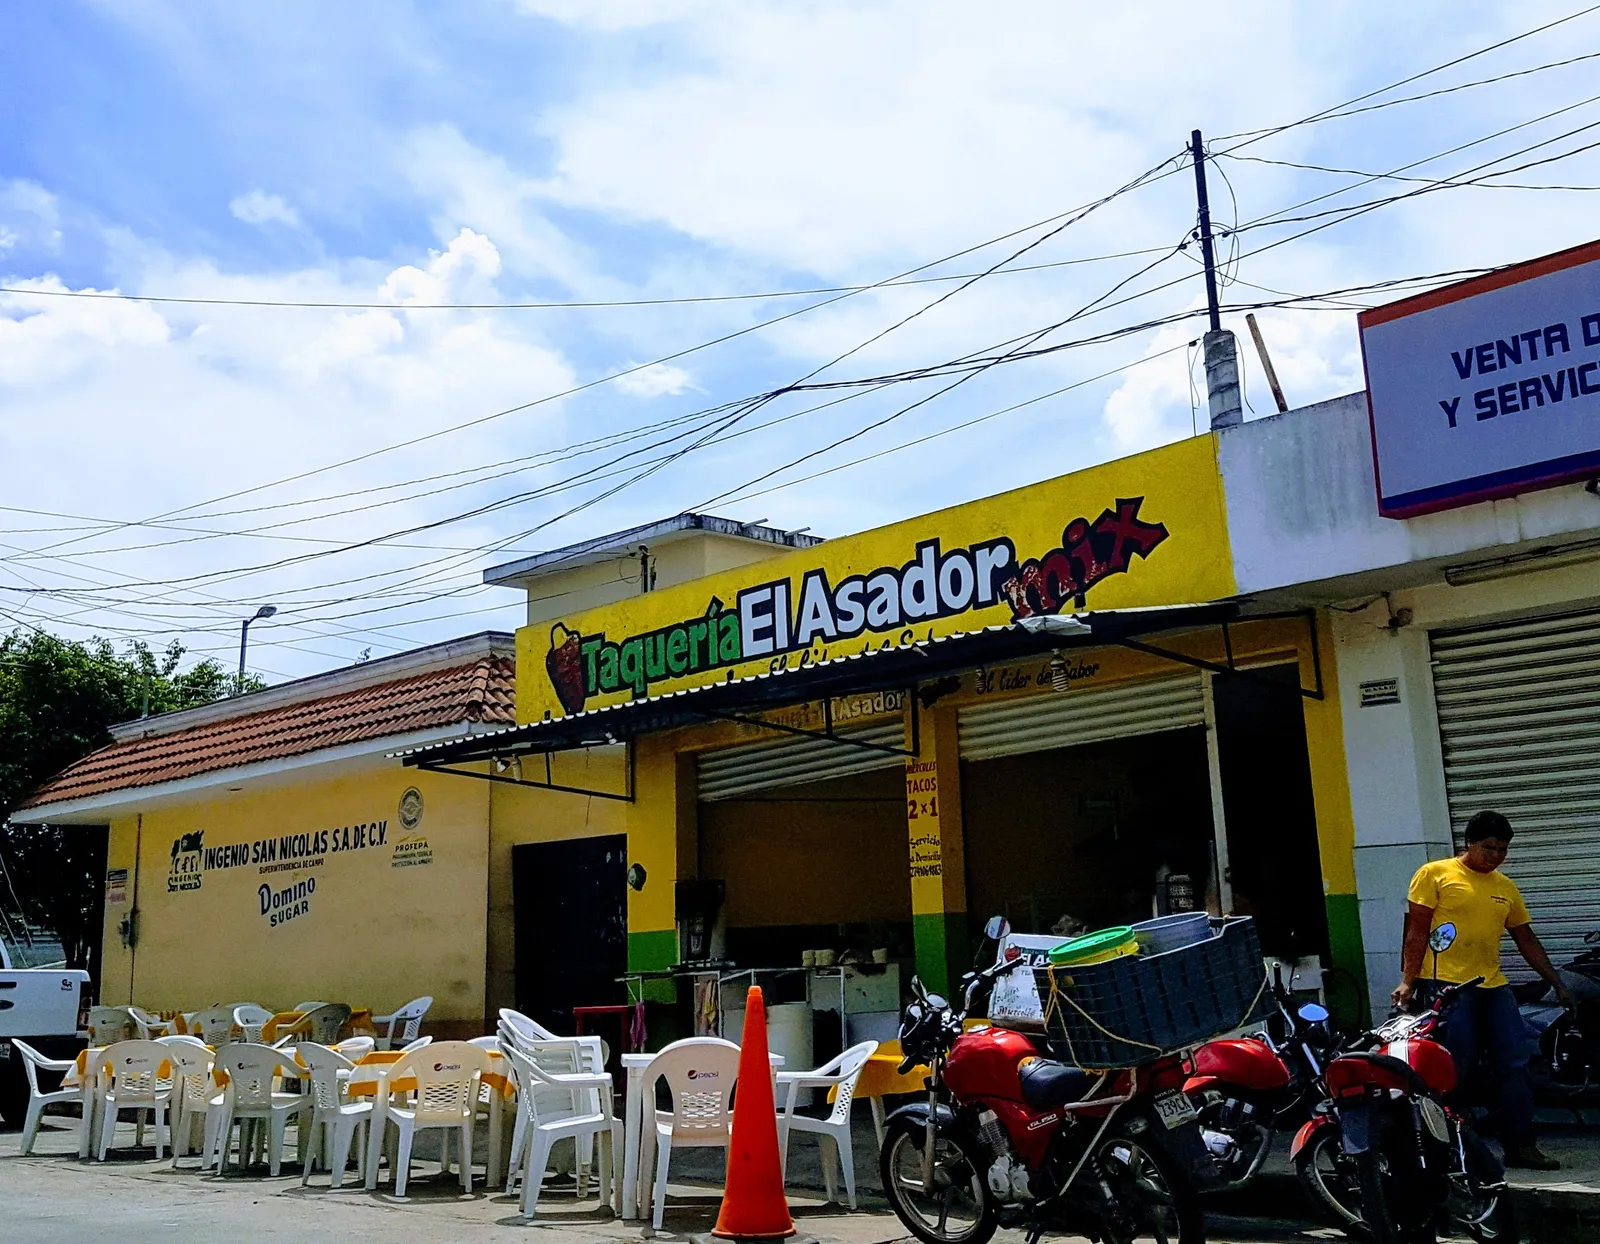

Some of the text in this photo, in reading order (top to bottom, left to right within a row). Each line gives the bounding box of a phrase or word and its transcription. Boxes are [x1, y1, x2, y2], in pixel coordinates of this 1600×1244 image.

[1451, 322, 1571, 380] VENTA
[1439, 361, 1600, 428] Y SERVIC
[580, 498, 1168, 694] Taquería El Asador mix
[837, 688, 906, 720] Asador
[907, 777, 937, 795] TACOS
[204, 843, 249, 870] INGENIO
[252, 838, 277, 863] SAN
[280, 830, 328, 860] NICOLAS
[368, 820, 388, 847] C.V.
[395, 841, 429, 852] PROFEPA
[910, 833, 940, 848] Servicio
[259, 861, 301, 874] SUPERINTENDENCIA
[258, 877, 316, 916] Domino
[270, 900, 309, 927] SUGAR
[698, 1071, 719, 1079] pepsi
